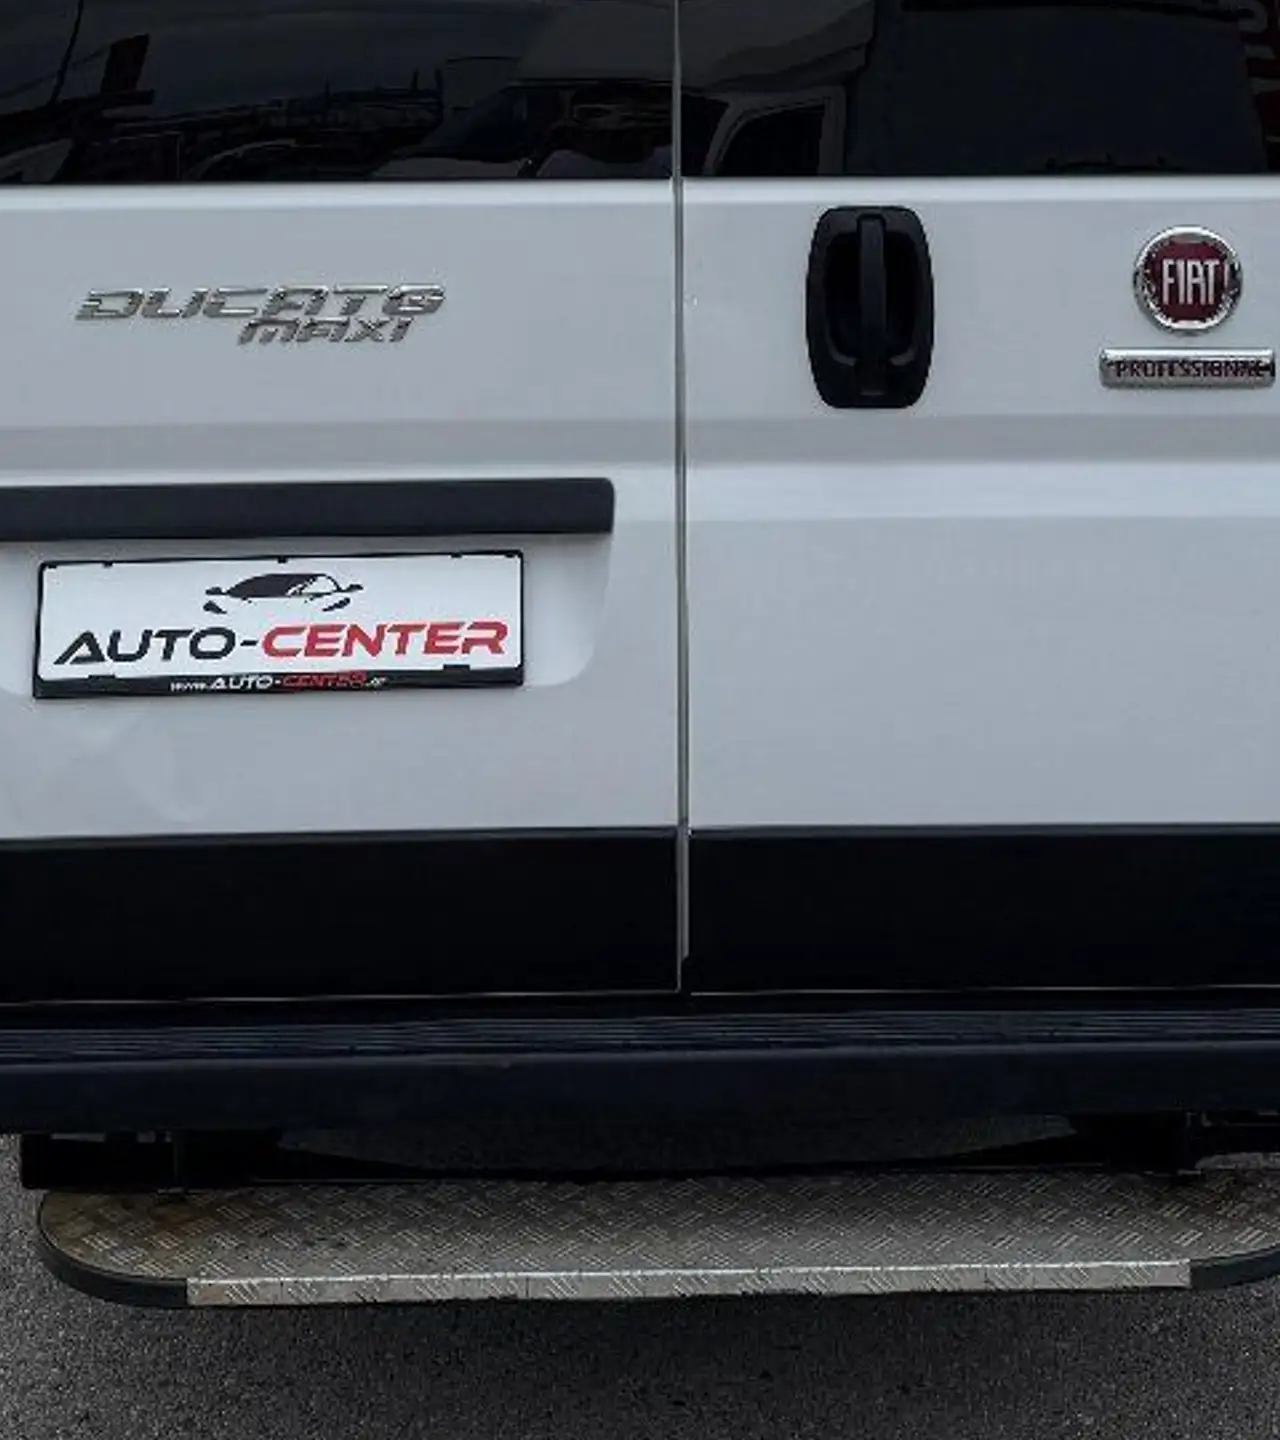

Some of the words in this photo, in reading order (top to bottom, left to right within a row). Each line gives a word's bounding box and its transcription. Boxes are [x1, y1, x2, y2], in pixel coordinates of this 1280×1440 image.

[75, 284, 446, 319] DUCATO
[1163, 259, 1219, 305] FIAT
[237, 317, 414, 346] MAXI
[53, 621, 509, 666] AUTO-CENTER
